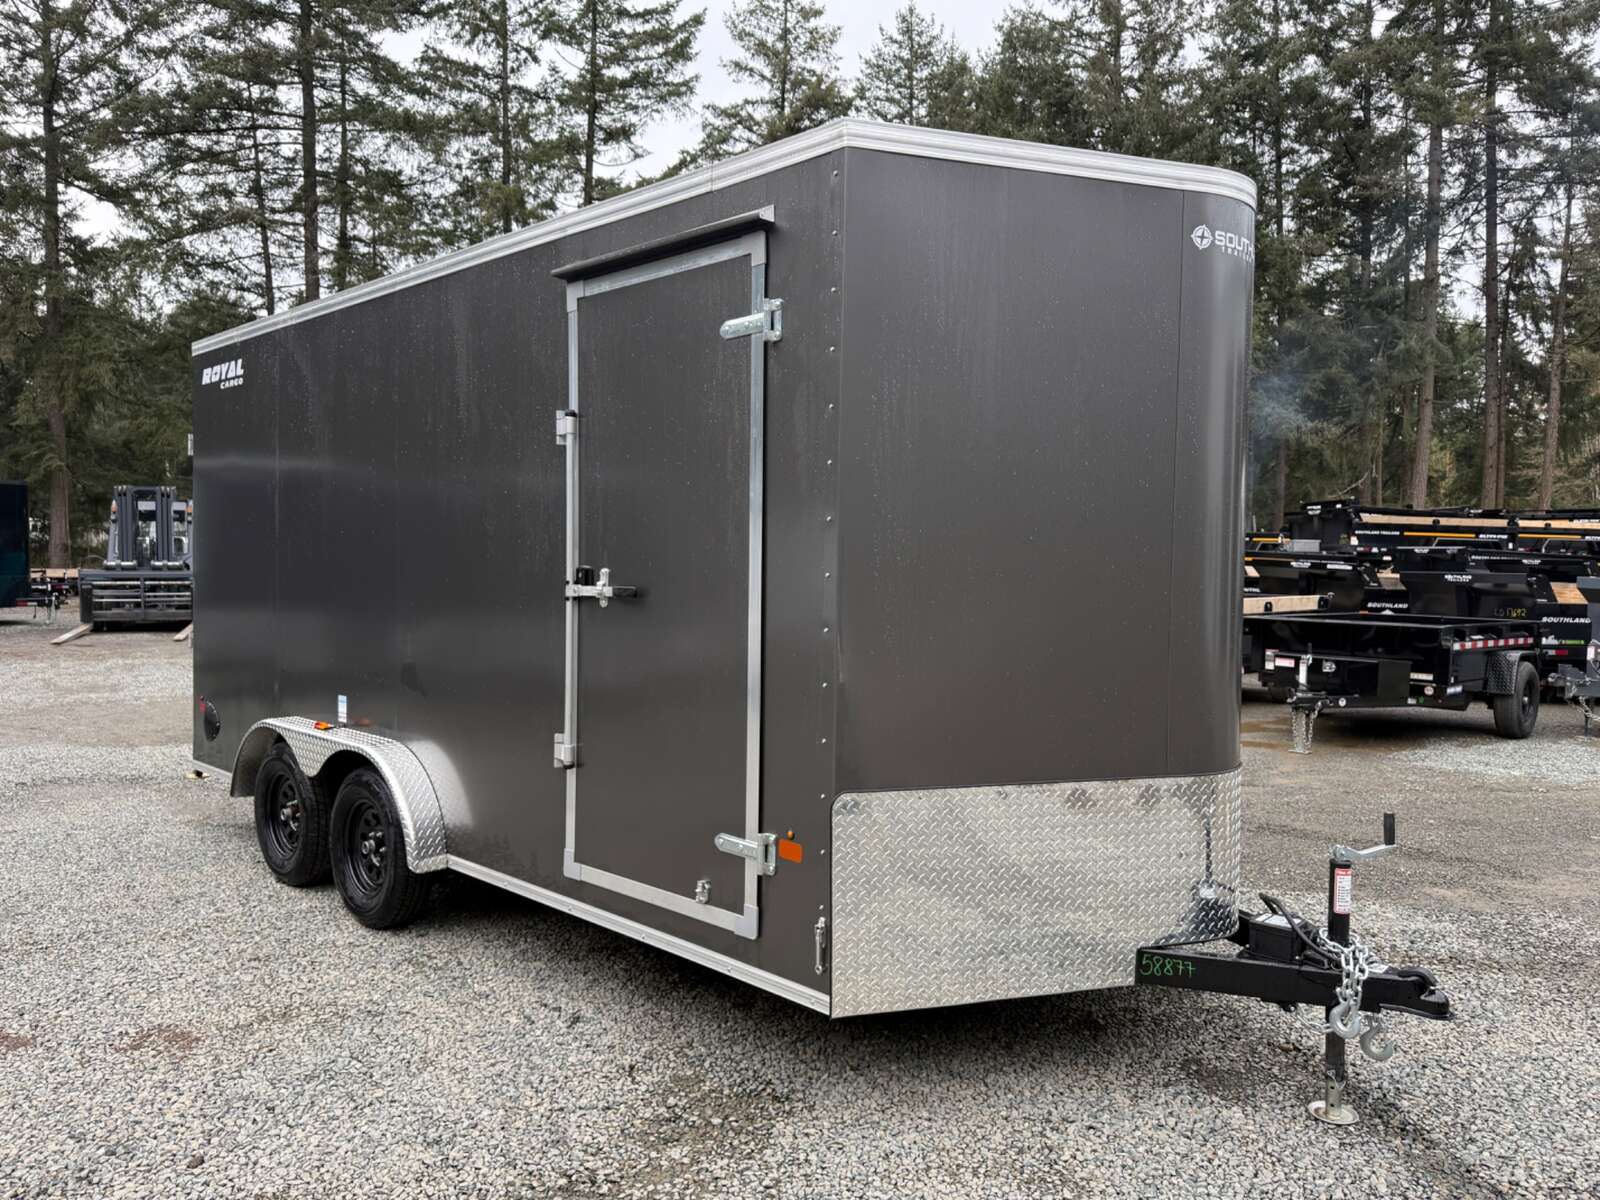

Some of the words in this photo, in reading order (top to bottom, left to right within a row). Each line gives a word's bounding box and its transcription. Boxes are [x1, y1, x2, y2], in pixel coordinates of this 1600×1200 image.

[202, 358, 244, 385] ROYAL
[220, 377, 244, 389] CARGO
[1367, 601, 1409, 609] SOUTHLAND
[1541, 616, 1592, 624] SOUTHLAND
[1140, 954, 1196, 977] 58877
